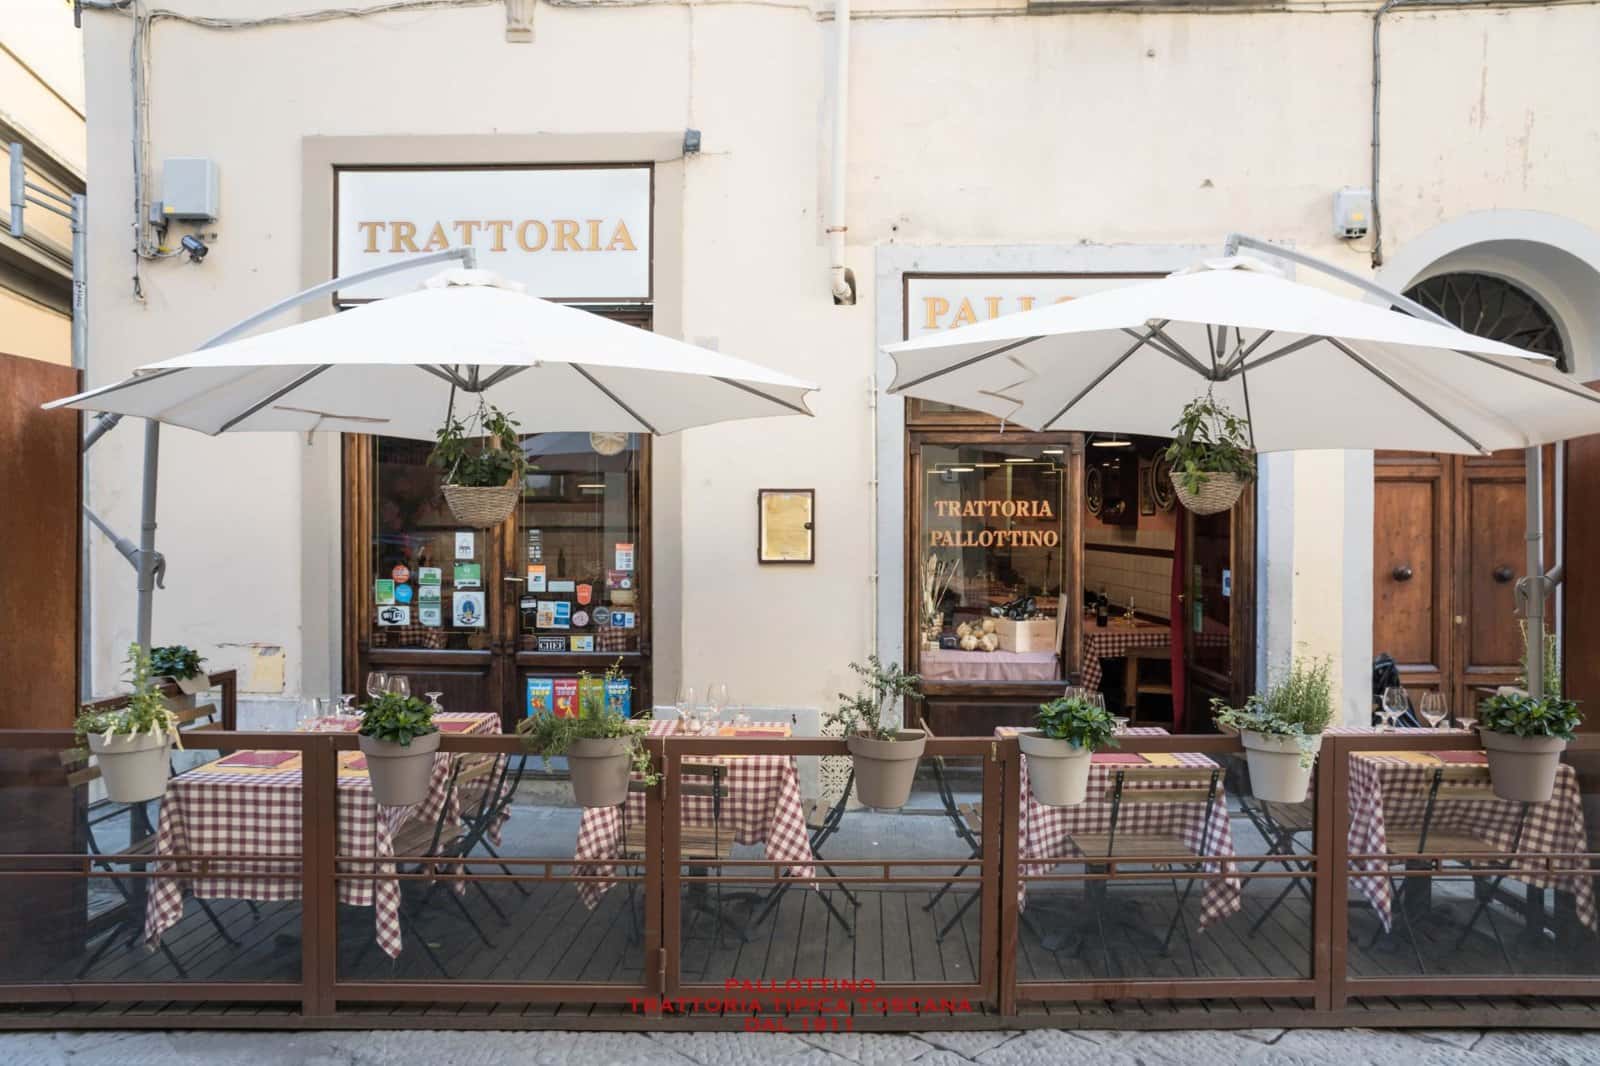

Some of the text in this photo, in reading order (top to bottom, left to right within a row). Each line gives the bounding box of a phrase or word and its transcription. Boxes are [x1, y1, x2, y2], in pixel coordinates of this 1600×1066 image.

[357, 218, 638, 253] TRATTORIA
[934, 499, 1053, 518] TRATTORIA
[930, 529, 1059, 549] PALLOTTINO
